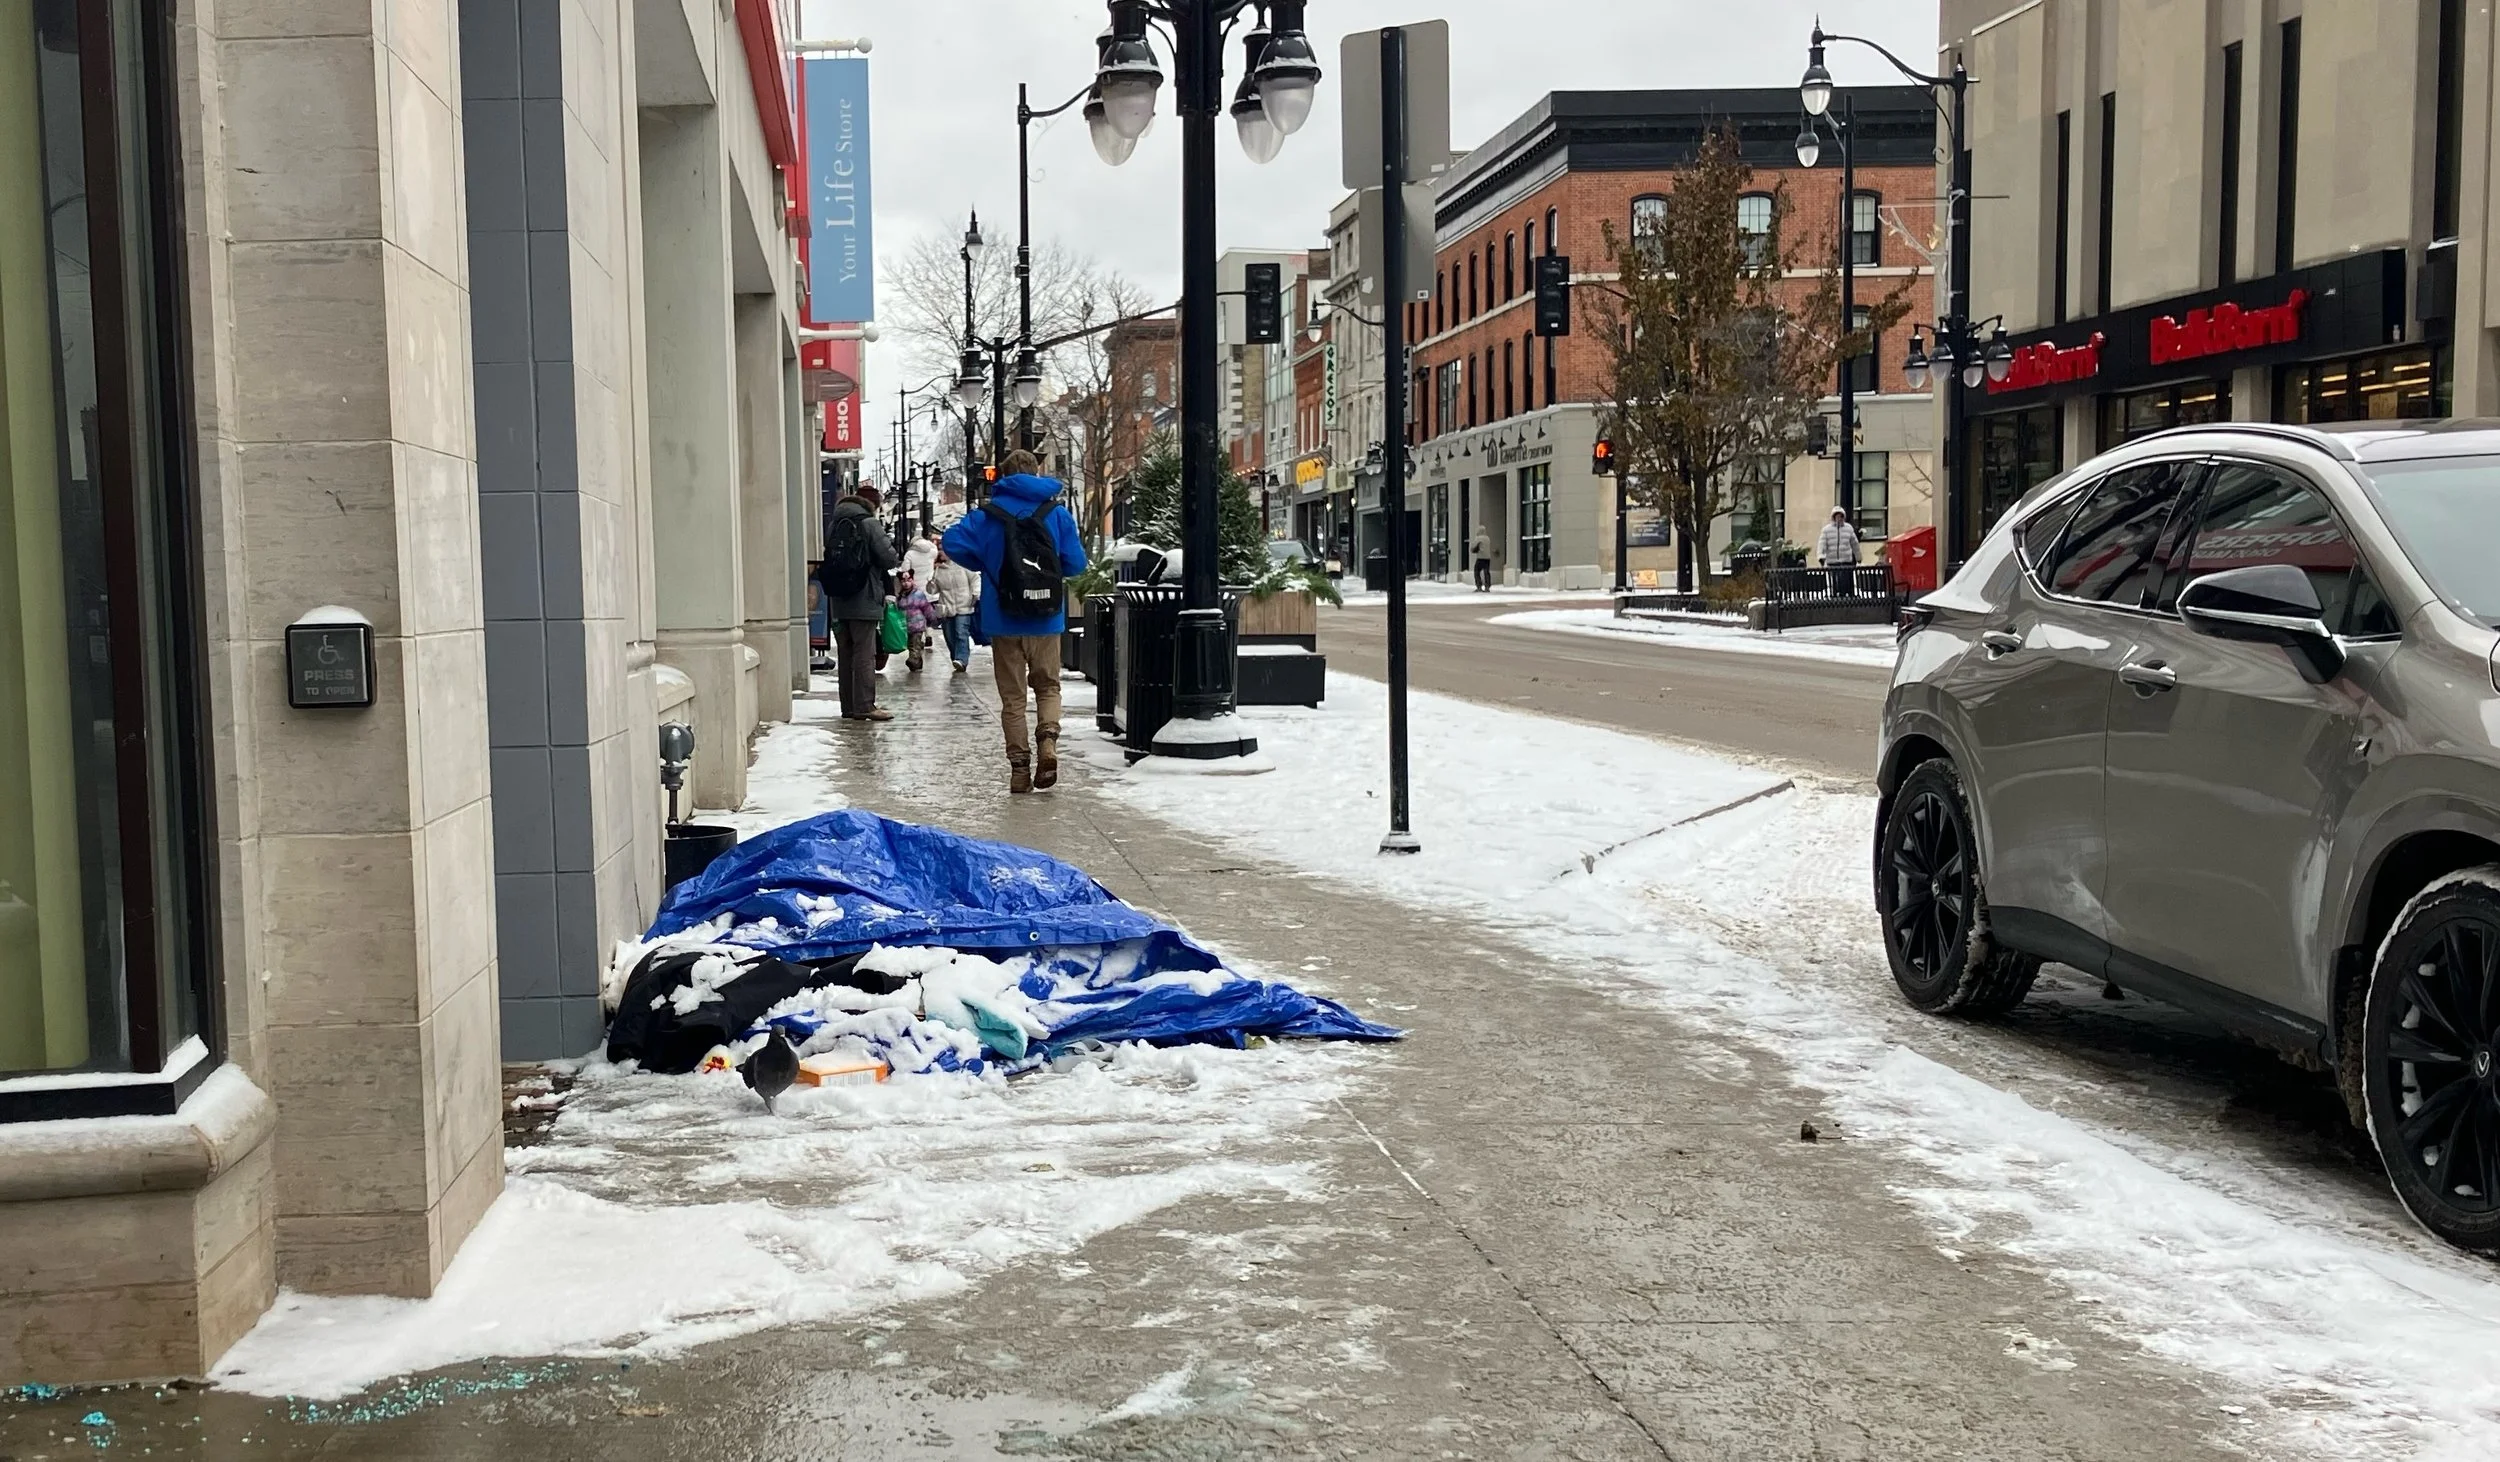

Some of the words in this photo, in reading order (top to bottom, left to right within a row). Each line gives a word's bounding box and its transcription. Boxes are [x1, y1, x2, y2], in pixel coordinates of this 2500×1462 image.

[835, 98, 853, 153] Store
[824, 159, 857, 229] Life
[839, 235, 857, 284] Your
[1326, 346, 1335, 422] GRECOS
[837, 398, 849, 442] SHO
[304, 669, 355, 682] PRESS
[305, 686, 320, 696] TO
[325, 685, 355, 695] OPEN
